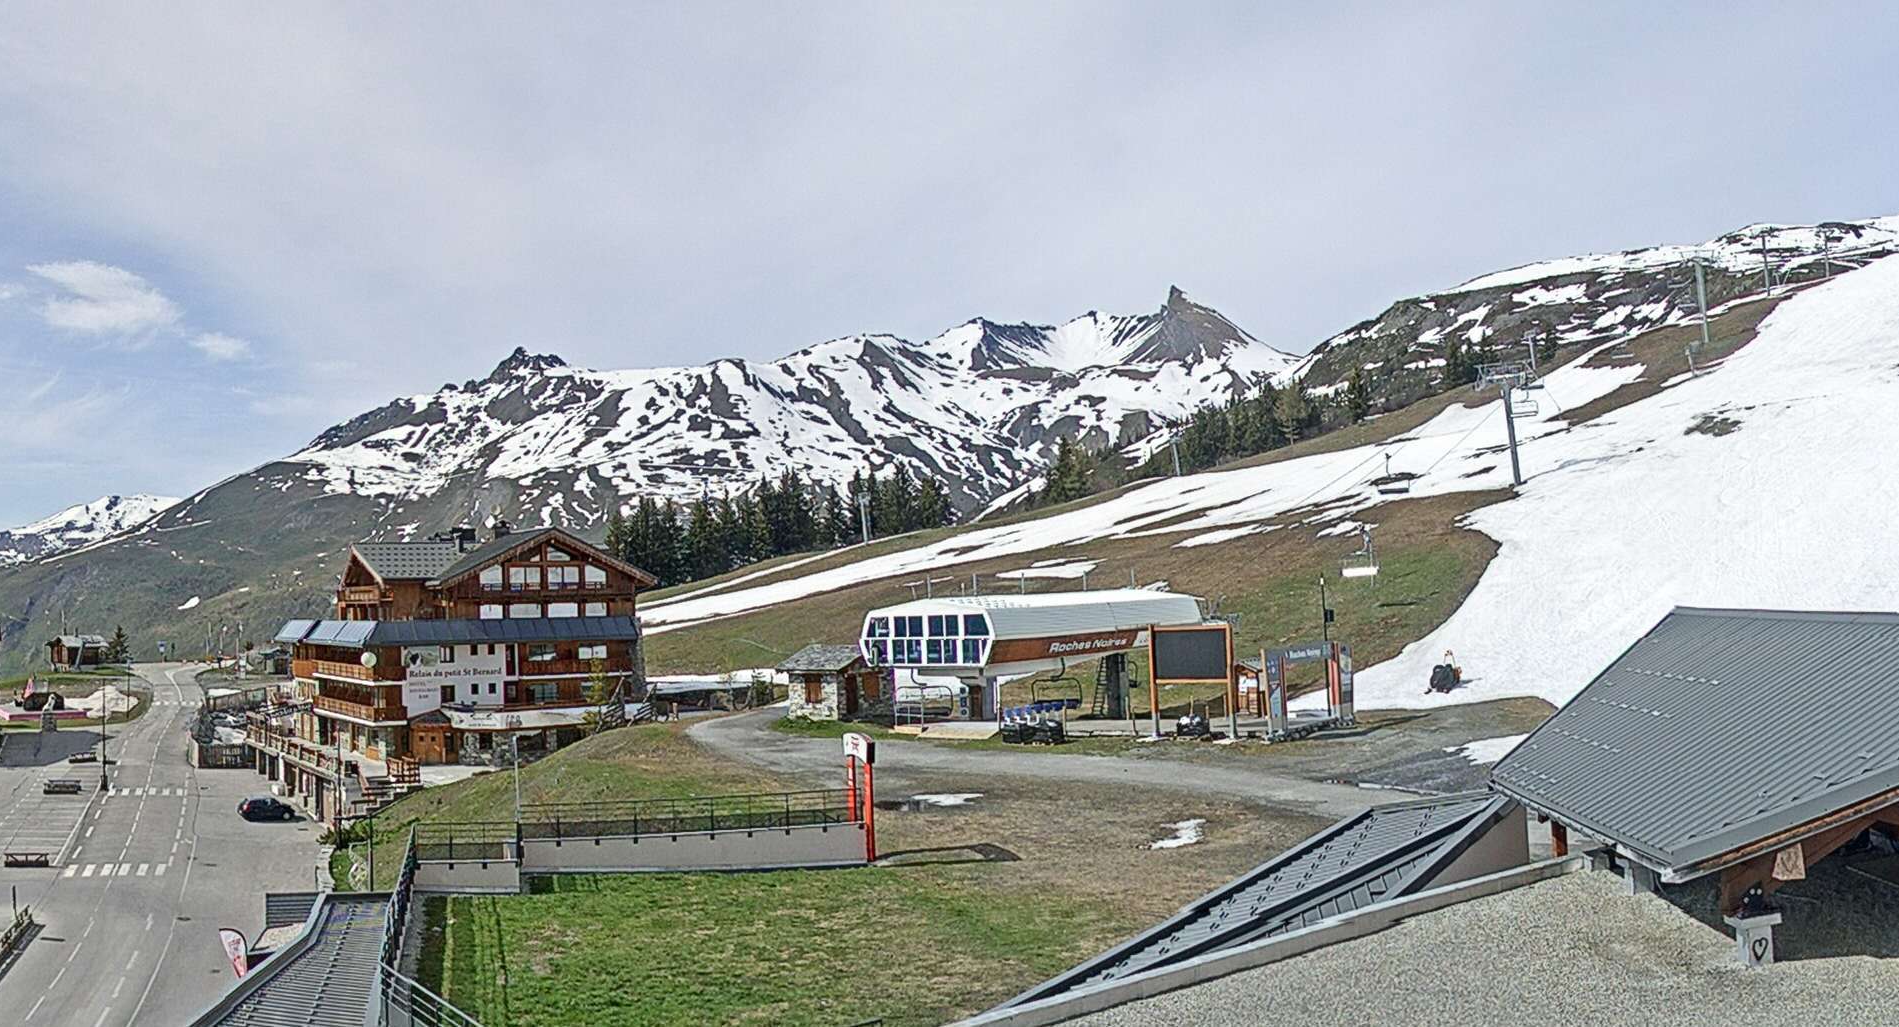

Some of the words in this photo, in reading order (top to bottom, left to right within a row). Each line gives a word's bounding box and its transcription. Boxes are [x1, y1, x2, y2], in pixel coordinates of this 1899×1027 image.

[1049, 640, 1092, 653] Roches
[1092, 638, 1128, 649] Noires
[463, 668, 472, 676] St
[473, 667, 502, 676] Bernard
